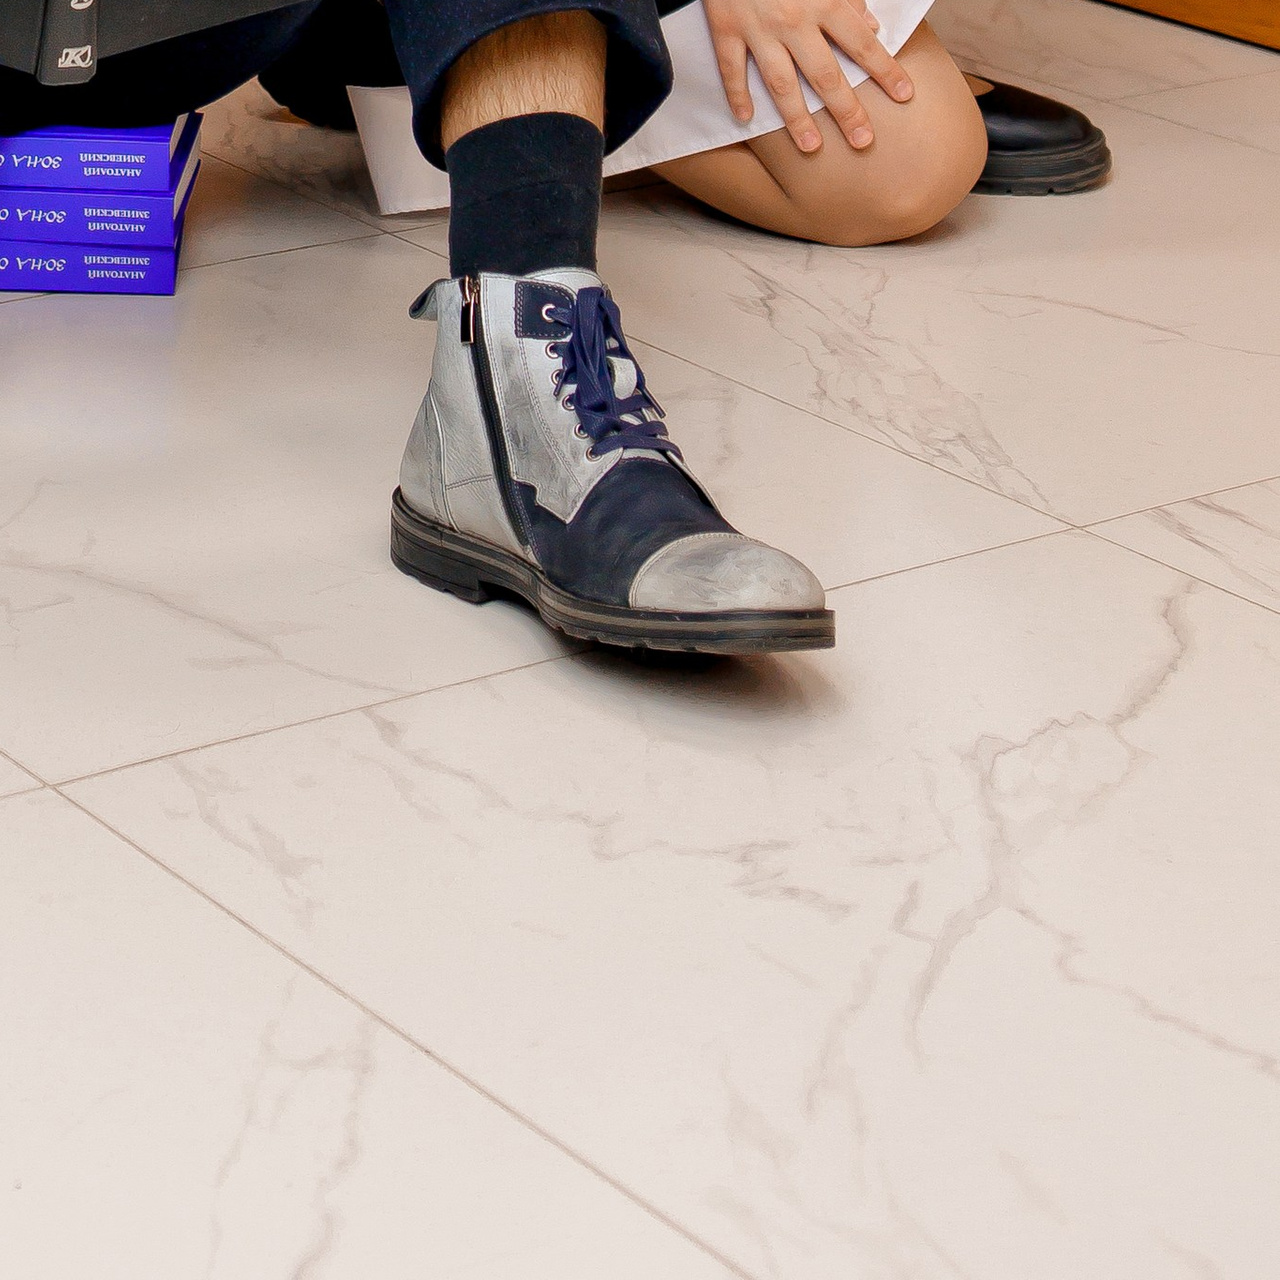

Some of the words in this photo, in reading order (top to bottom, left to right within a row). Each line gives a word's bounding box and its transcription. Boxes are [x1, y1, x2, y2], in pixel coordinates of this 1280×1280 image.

[12, 154, 63, 169] ЗОНА
[79, 153, 145, 164] ЗМИЕВСКИЙ
[83, 167, 142, 178] АНАТОЛИЙ
[17, 208, 67, 223] ЗОНА
[84, 207, 150, 219] ЗМИЕВСКИЙ
[87, 221, 146, 232] АНАТОЛИЙ
[17, 256, 67, 271] ЗОНА
[83, 255, 150, 266] ЗМИЕВСКИЙ
[87, 269, 146, 280] АНАТОЛИЙ
